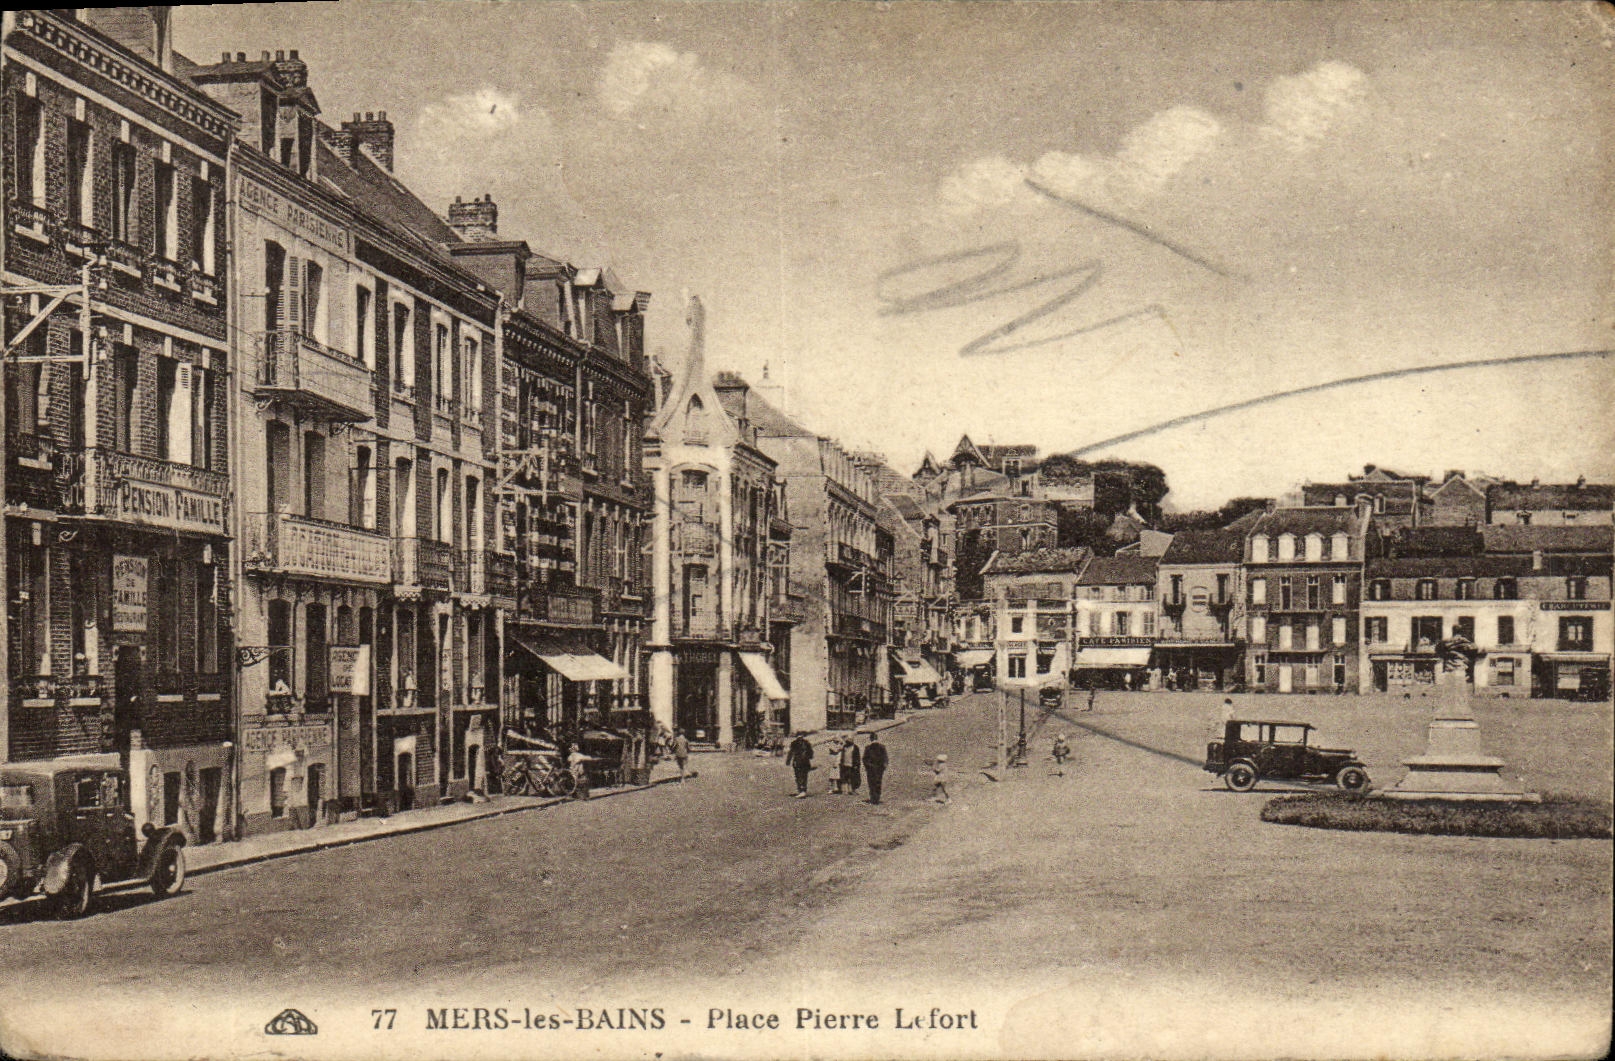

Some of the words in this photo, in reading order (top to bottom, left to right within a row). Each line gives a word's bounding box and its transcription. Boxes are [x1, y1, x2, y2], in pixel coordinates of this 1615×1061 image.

[240, 178, 279, 214] AGENCE
[286, 203, 344, 249] PARISIENNE
[121, 482, 169, 518] PENSION
[175, 490, 221, 526] FAMILLE
